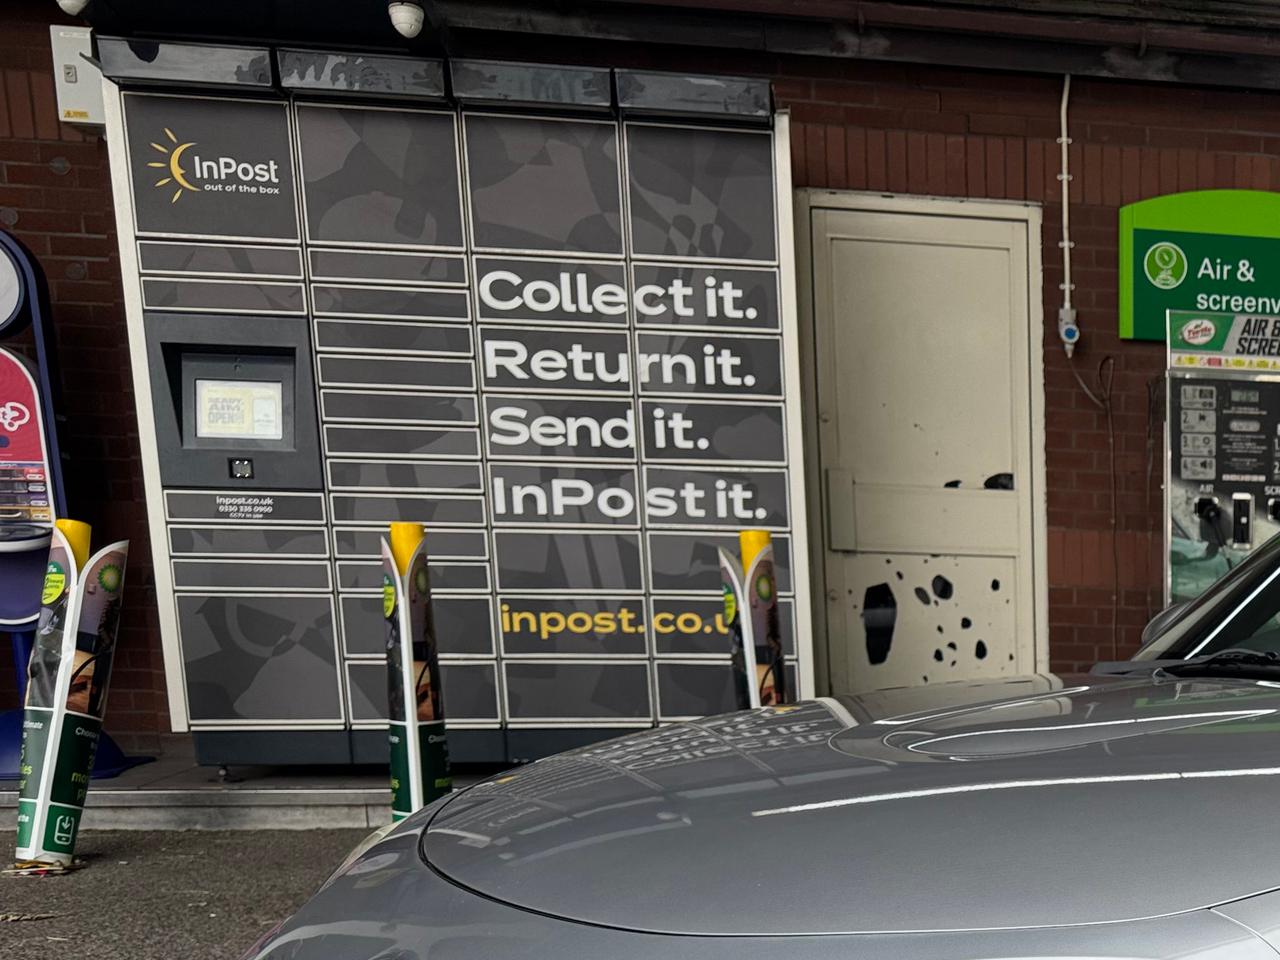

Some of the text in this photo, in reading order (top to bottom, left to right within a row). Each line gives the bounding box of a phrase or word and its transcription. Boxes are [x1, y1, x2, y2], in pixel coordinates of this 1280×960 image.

[194, 155, 279, 183] InPost
[204, 183, 280, 195] out of the box
[1197, 257, 1255, 282] Air &
[479, 270, 759, 320] Collect it.
[1240, 318, 1269, 337] AIR
[485, 340, 757, 388] Return it.
[489, 406, 710, 450] Send it.
[493, 477, 768, 520] InPost it.
[1199, 484, 1214, 494] AIR
[501, 604, 730, 641] inpost.co.u
